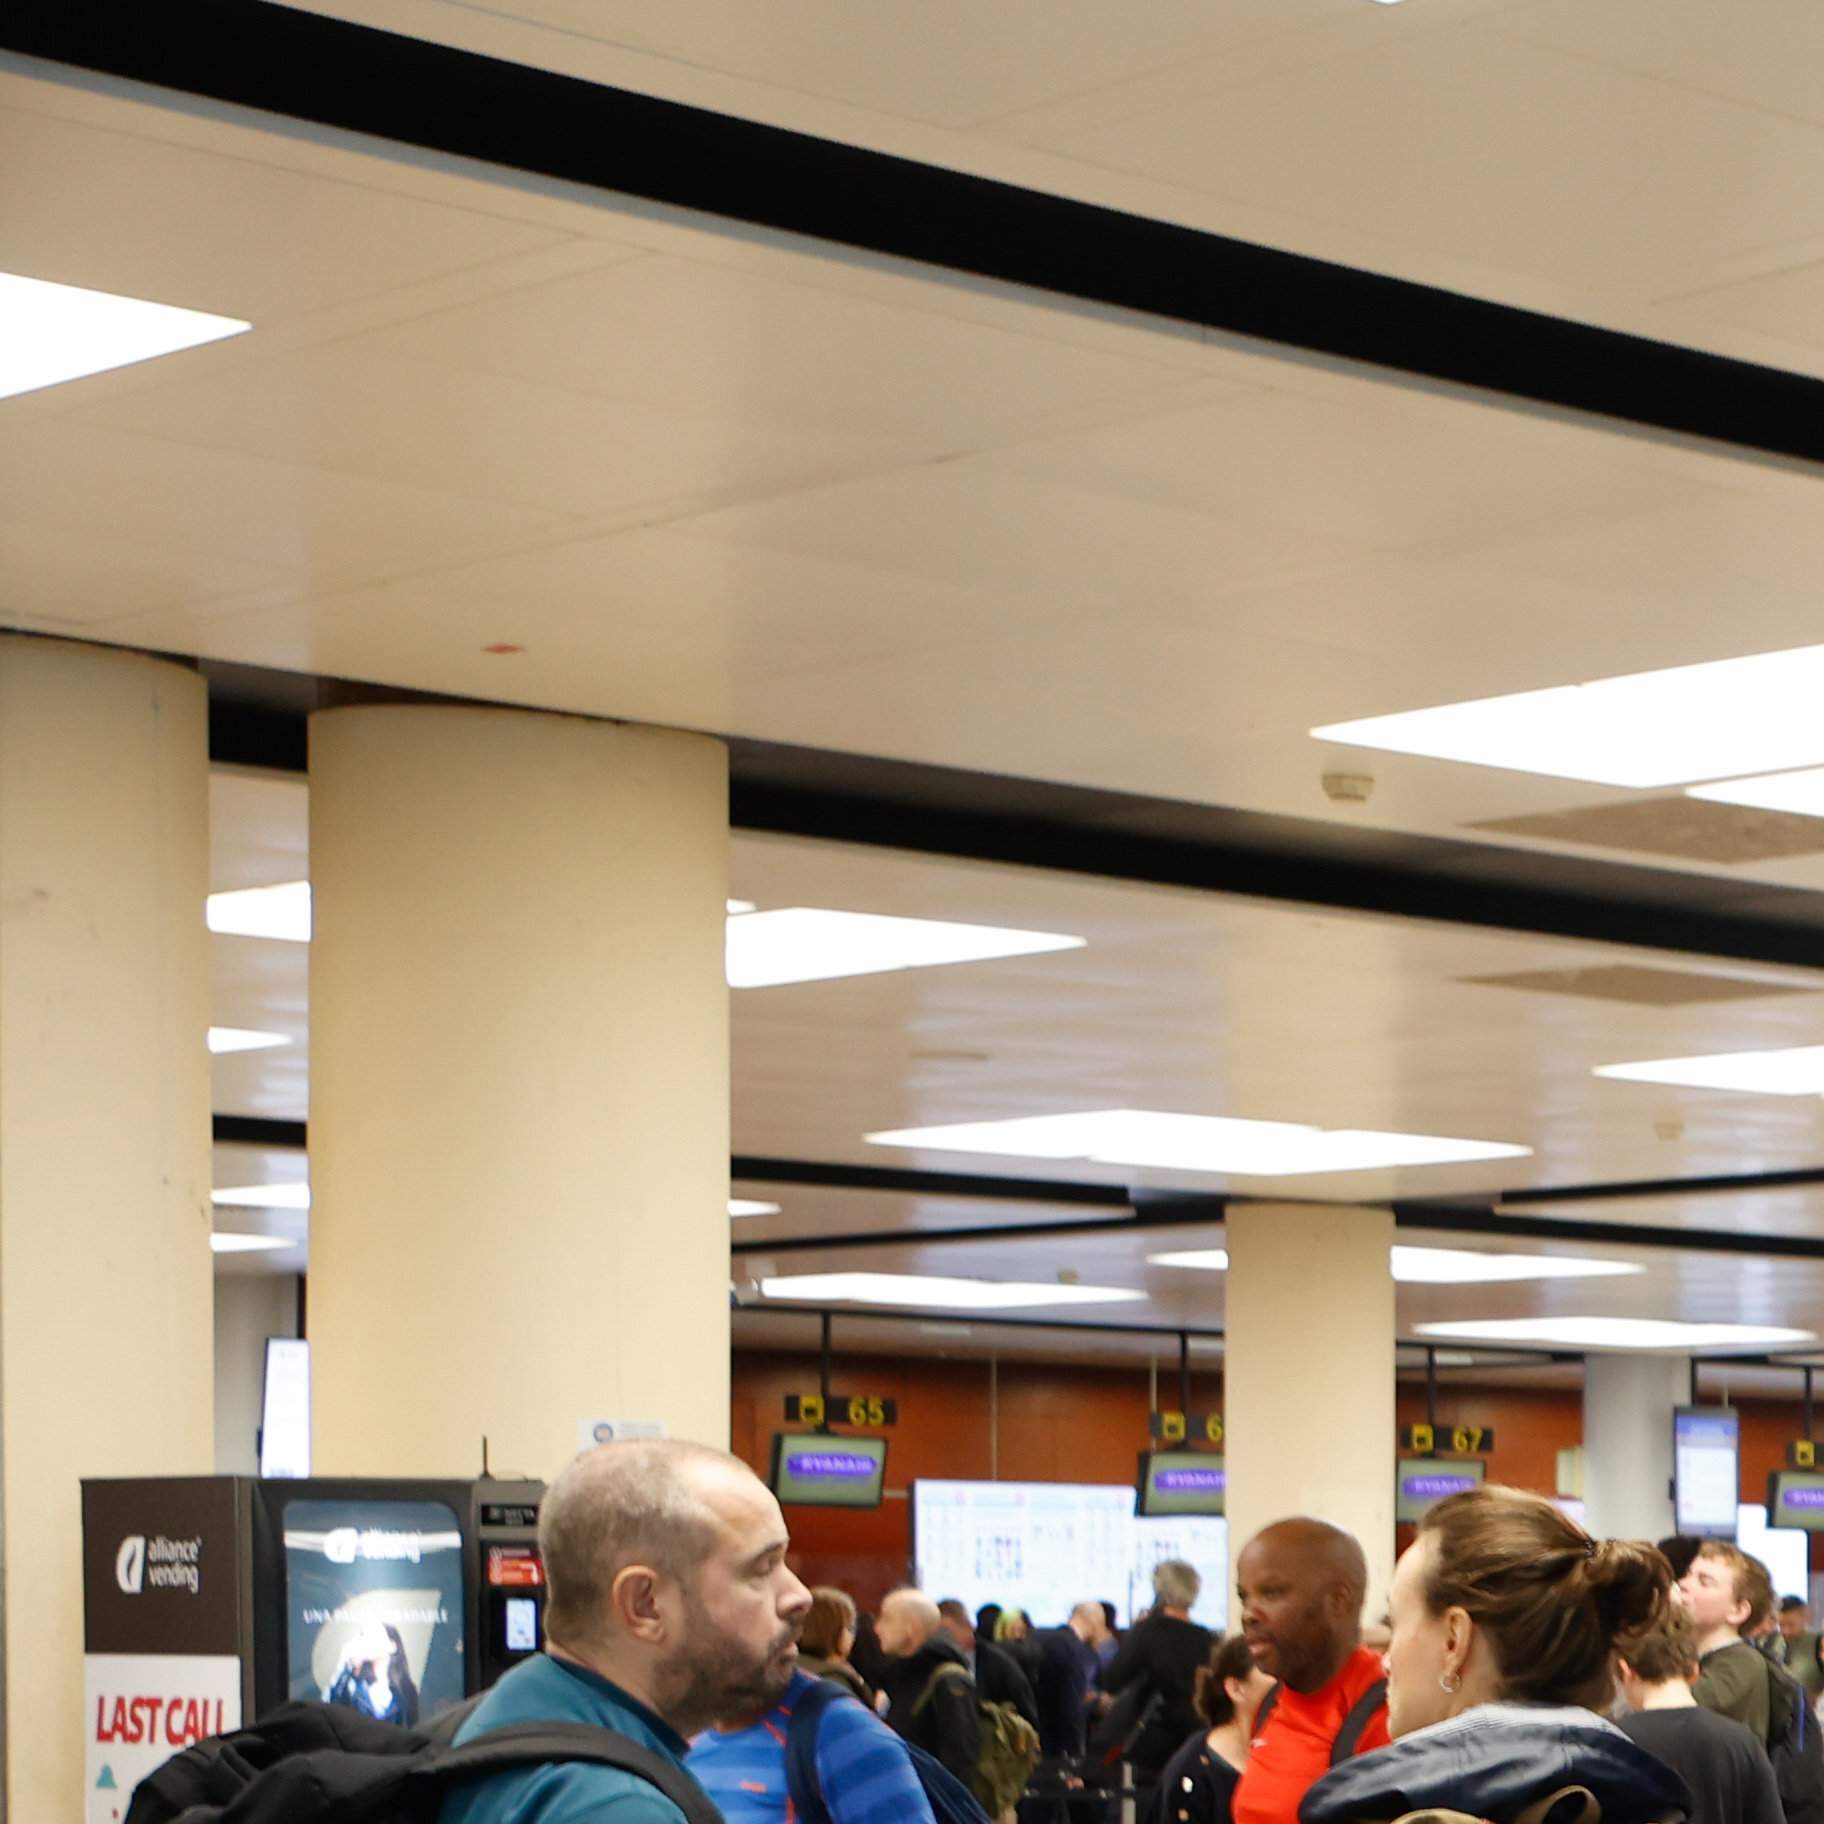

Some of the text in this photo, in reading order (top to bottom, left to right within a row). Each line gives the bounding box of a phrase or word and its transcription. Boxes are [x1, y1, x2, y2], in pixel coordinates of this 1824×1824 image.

[850, 1397, 884, 1426] 65
[1452, 1426, 1483, 1452] 67
[148, 1537, 199, 1562] alliance
[148, 1563, 199, 1593] vending
[97, 1697, 162, 1744] LAST
